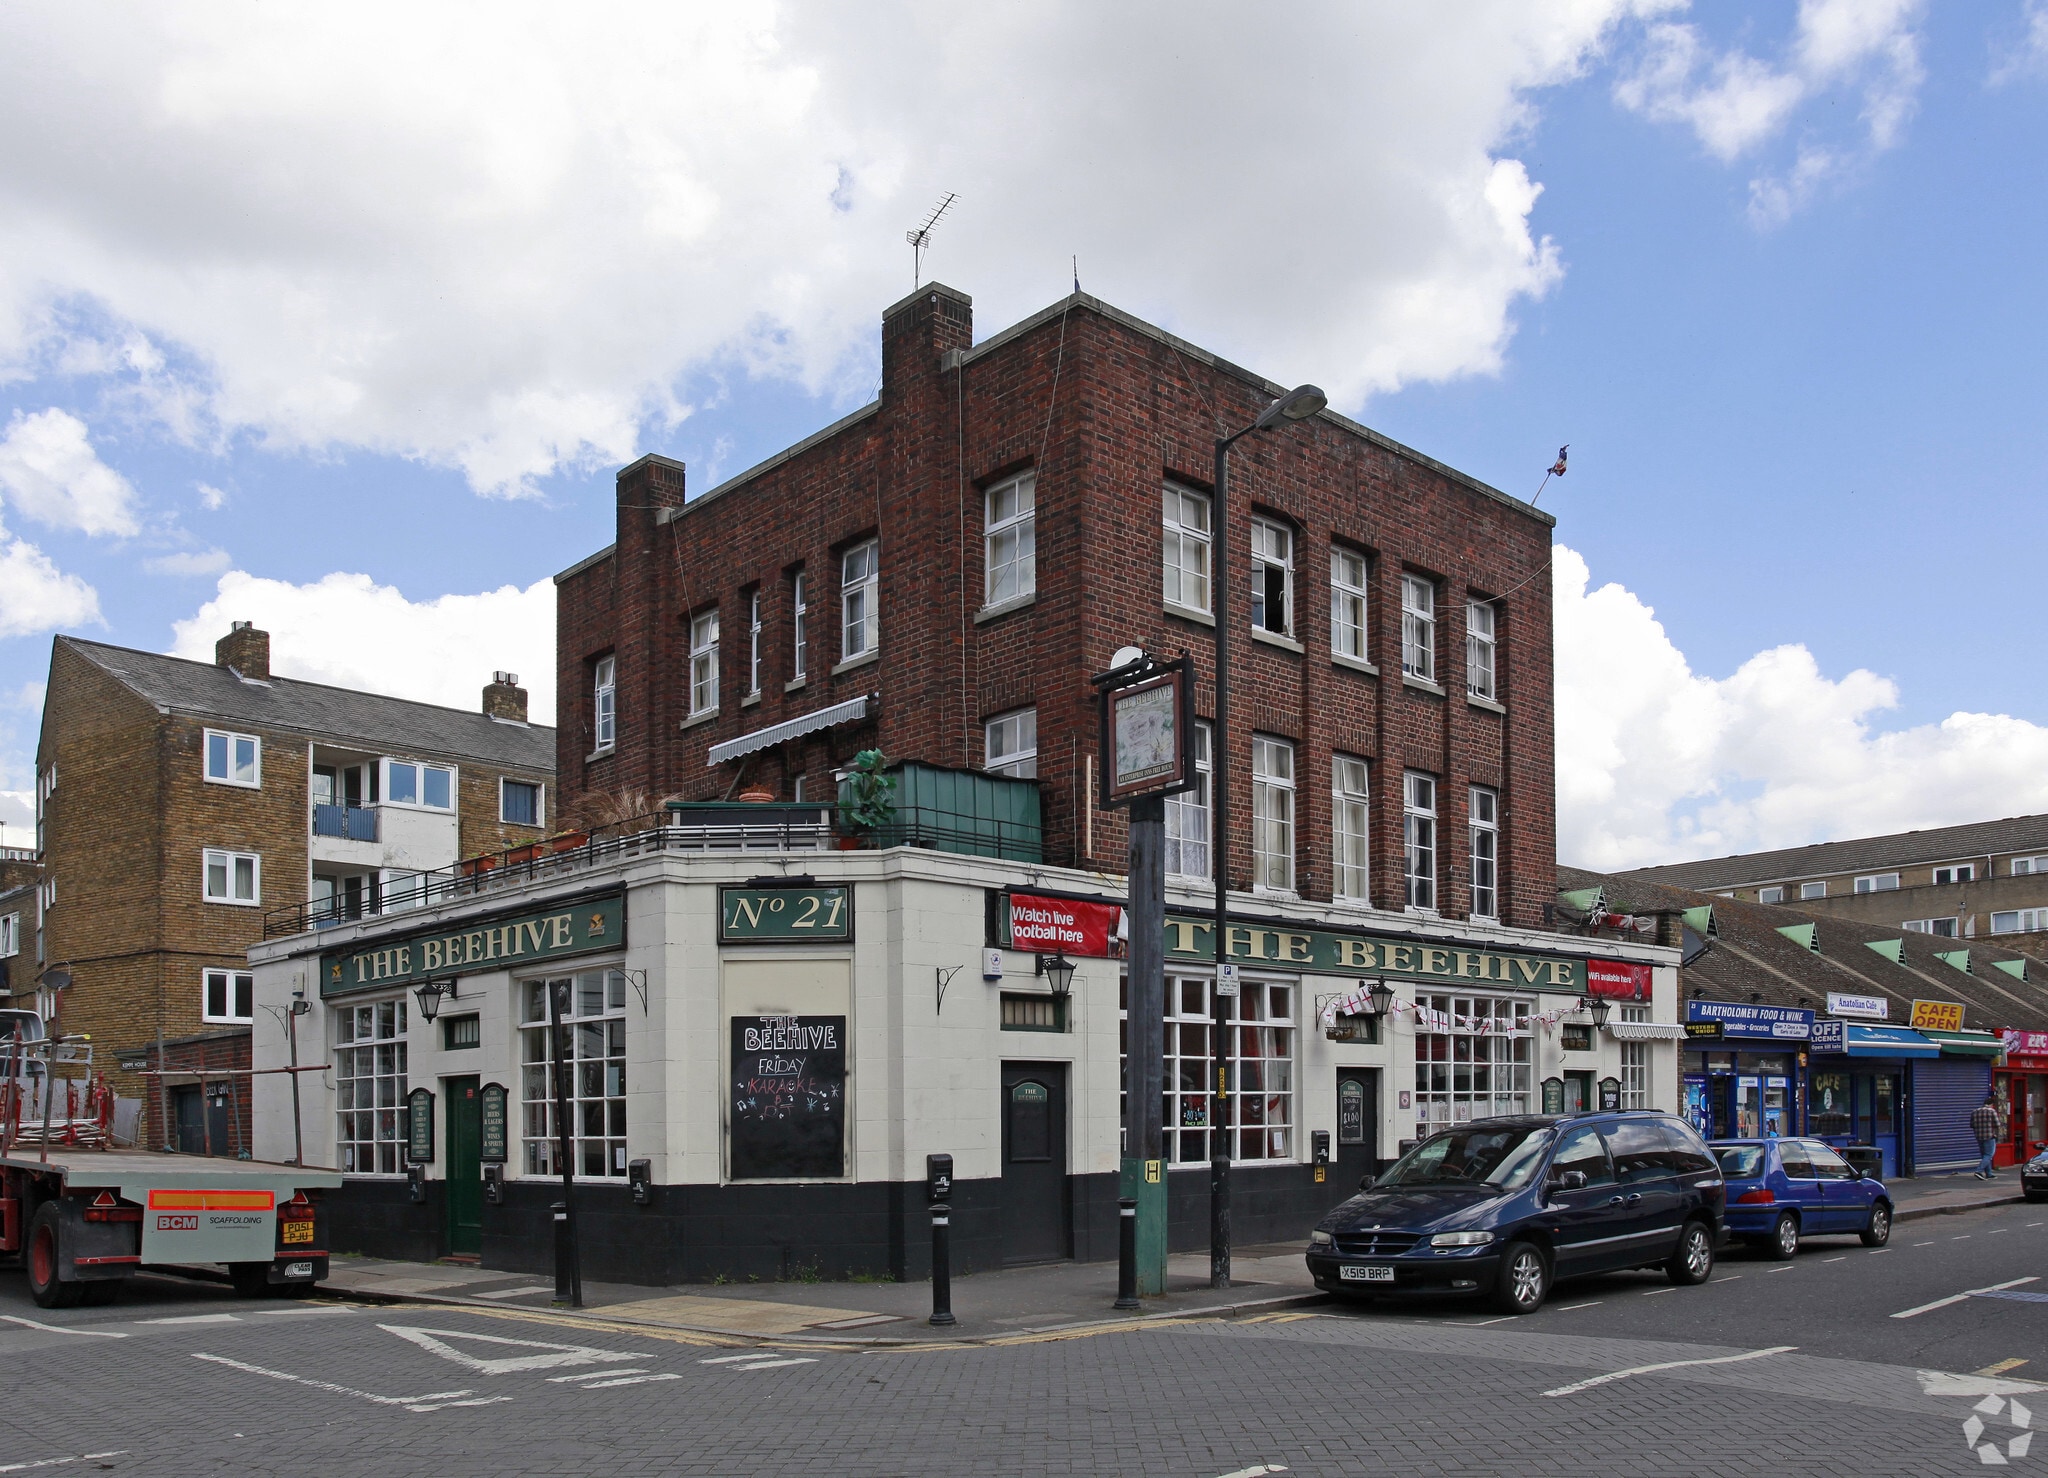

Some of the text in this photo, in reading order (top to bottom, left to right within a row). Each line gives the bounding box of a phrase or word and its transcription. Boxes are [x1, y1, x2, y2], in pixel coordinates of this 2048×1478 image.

[1012, 906, 1074, 926] Watch live
[1058, 929, 1083, 943] here
[353, 913, 573, 983] THE BEEHIVE
[1164, 918, 1574, 986] THE BEEHIVE
[1588, 971, 1600, 980] WiFi
[1838, 997, 1877, 1010] Anatolian Cafe
[1918, 1003, 1957, 1017] CAFE
[1701, 1005, 1803, 1021] BARTHOLOMEW FOOD & WINE
[760, 1016, 798, 1029] THE
[1724, 1022, 1770, 1032] egetables Groceries
[1812, 1023, 1840, 1035] OFF
[1914, 1015, 1957, 1030] OPEN
[745, 1026, 837, 1050] BEEHIVE
[758, 1055, 806, 1078] FRIDAY
[747, 1078, 817, 1095] KARAOKE
[1816, 1074, 1840, 1091] CAFE
[158, 1216, 262, 1229] BCM SCAFFOLDING
[290, 1232, 308, 1241] PJU
[1343, 1267, 1389, 1279] X519 BRP
